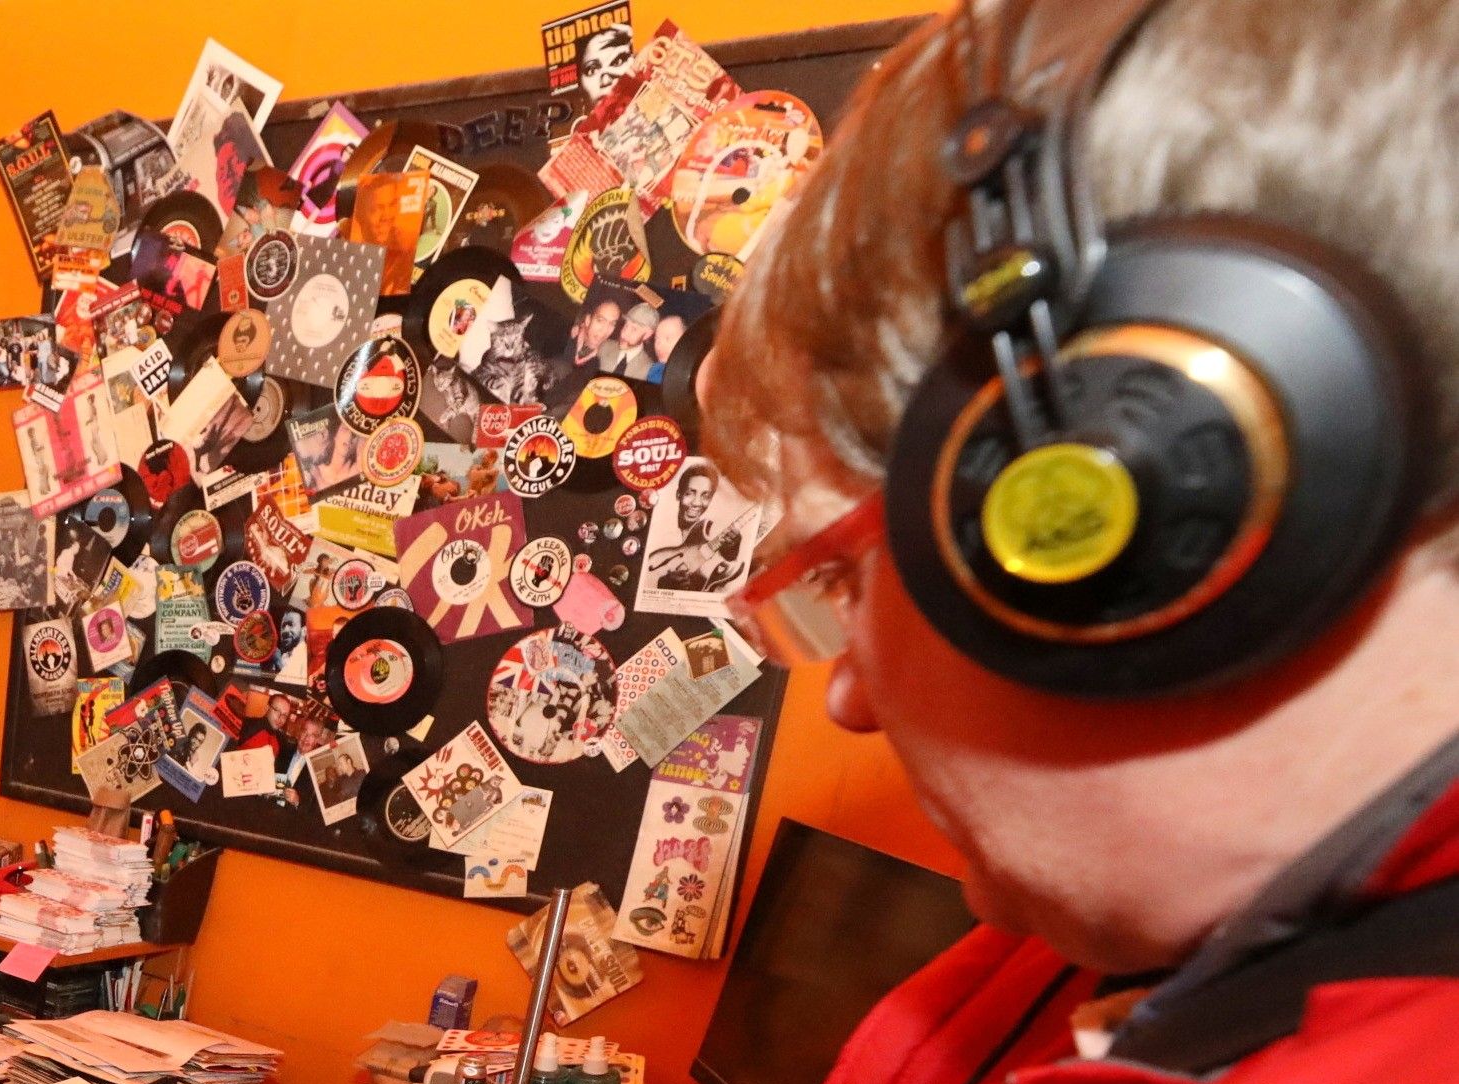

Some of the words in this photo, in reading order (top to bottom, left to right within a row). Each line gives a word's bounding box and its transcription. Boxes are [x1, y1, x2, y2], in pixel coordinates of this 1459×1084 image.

[137, 350, 164, 375] ACID
[505, 418, 574, 464] ALLNIGHTERS
[617, 442, 682, 467] SOUL
[510, 474, 554, 493] PRAGUE
[324, 497, 399, 521] Cocktailparad
[341, 482, 402, 512] nday
[536, 540, 568, 568] KEEPING
[525, 591, 551, 603] FAITH
